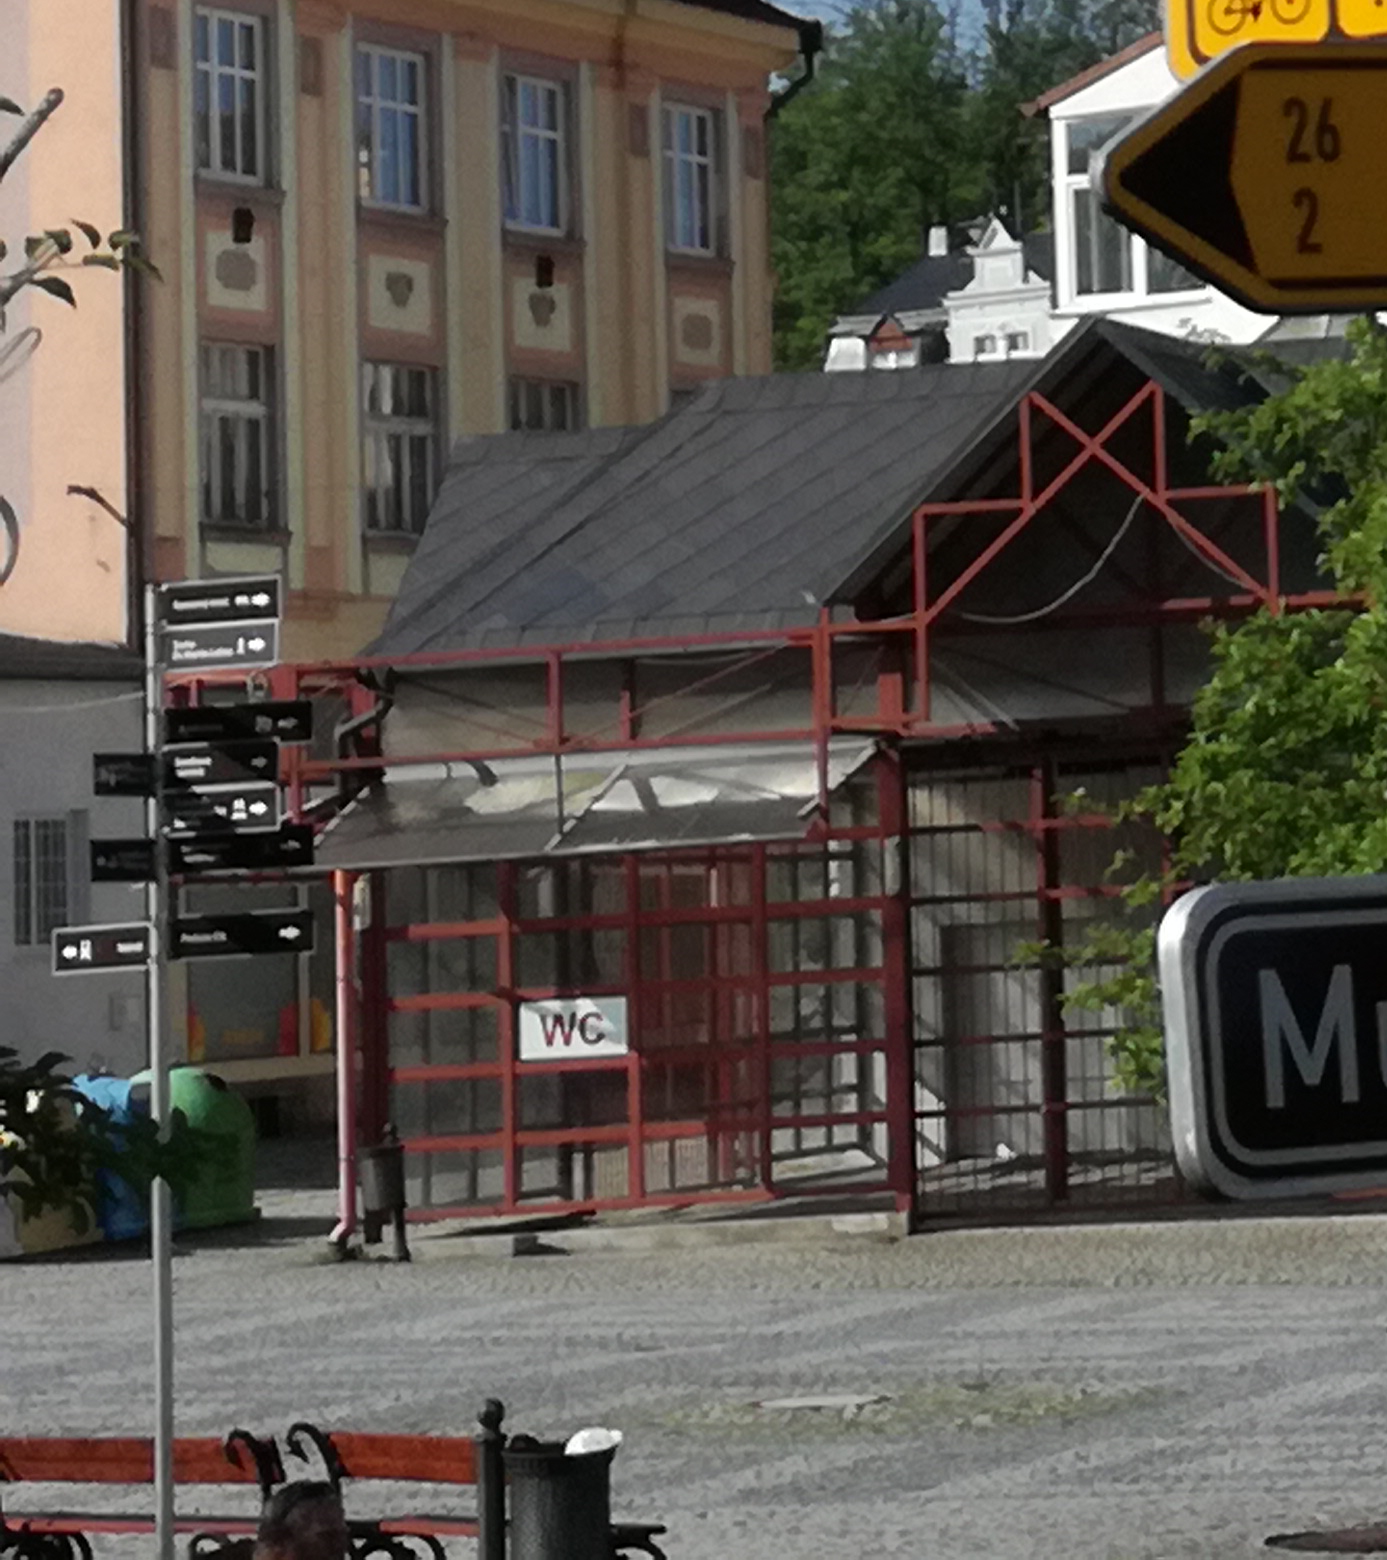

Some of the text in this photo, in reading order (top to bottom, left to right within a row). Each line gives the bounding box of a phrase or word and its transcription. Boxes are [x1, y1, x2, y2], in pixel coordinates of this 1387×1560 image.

[1283, 98, 1342, 164] 26
[1292, 187, 1323, 255] 2
[540, 1011, 606, 1046] WC
